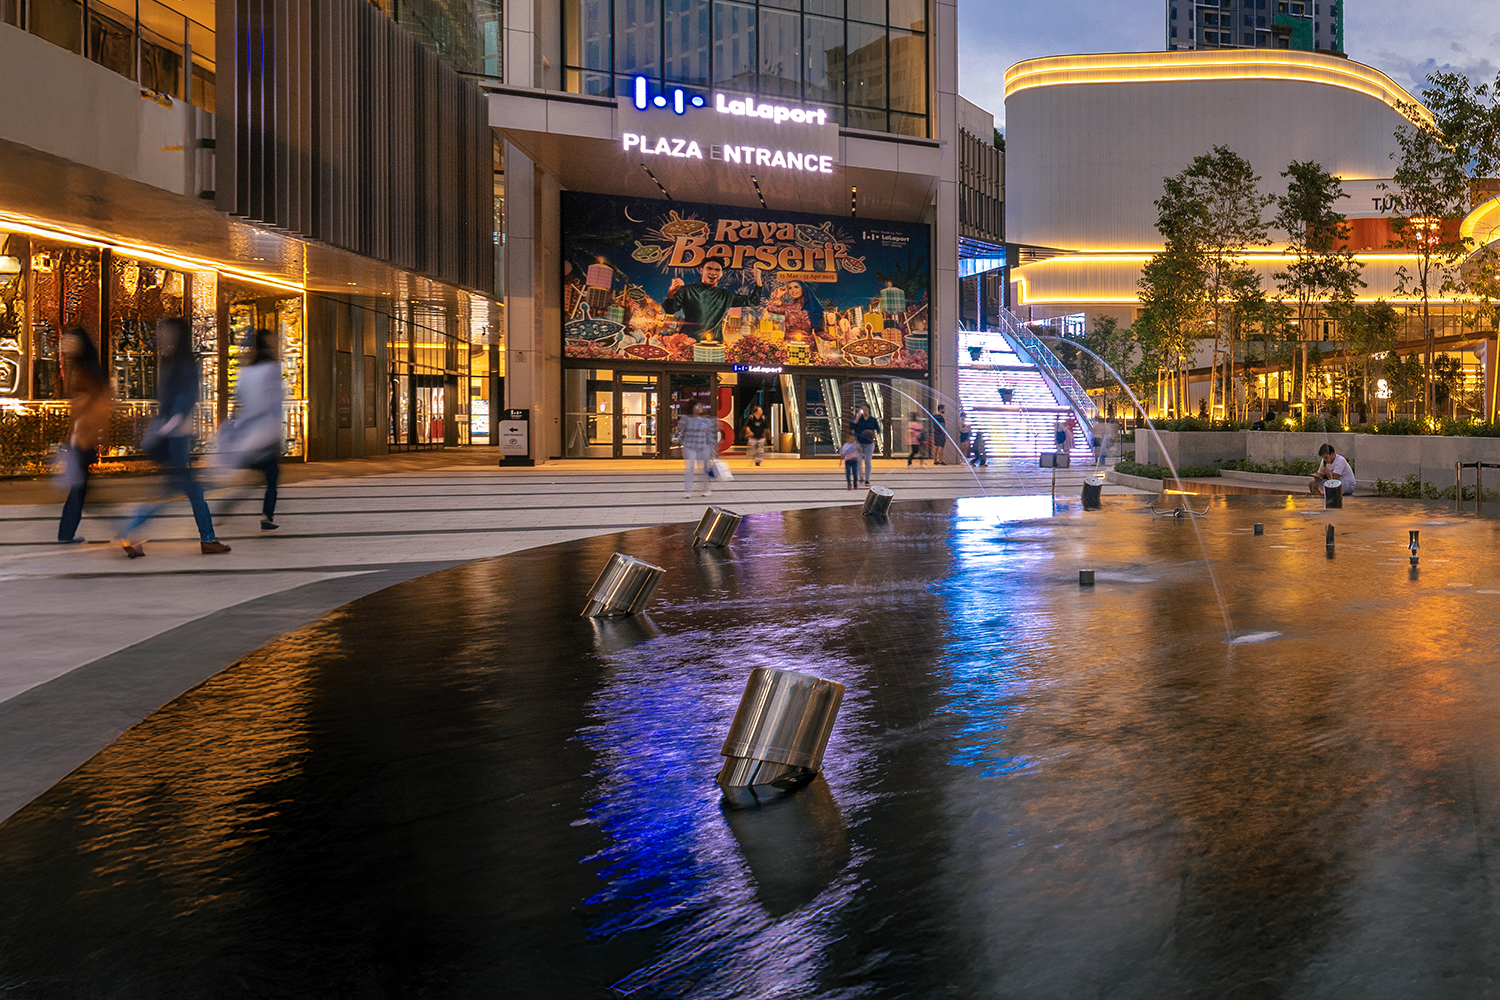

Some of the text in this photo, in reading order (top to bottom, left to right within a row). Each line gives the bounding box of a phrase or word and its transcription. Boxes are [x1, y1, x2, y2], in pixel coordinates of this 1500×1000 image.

[716, 93, 827, 125] LaLaport
[623, 133, 833, 173] PLAZA ENTRANCE
[715, 219, 796, 244] Raya
[748, 365, 783, 373] LaLaport
[814, 406, 824, 416] G
